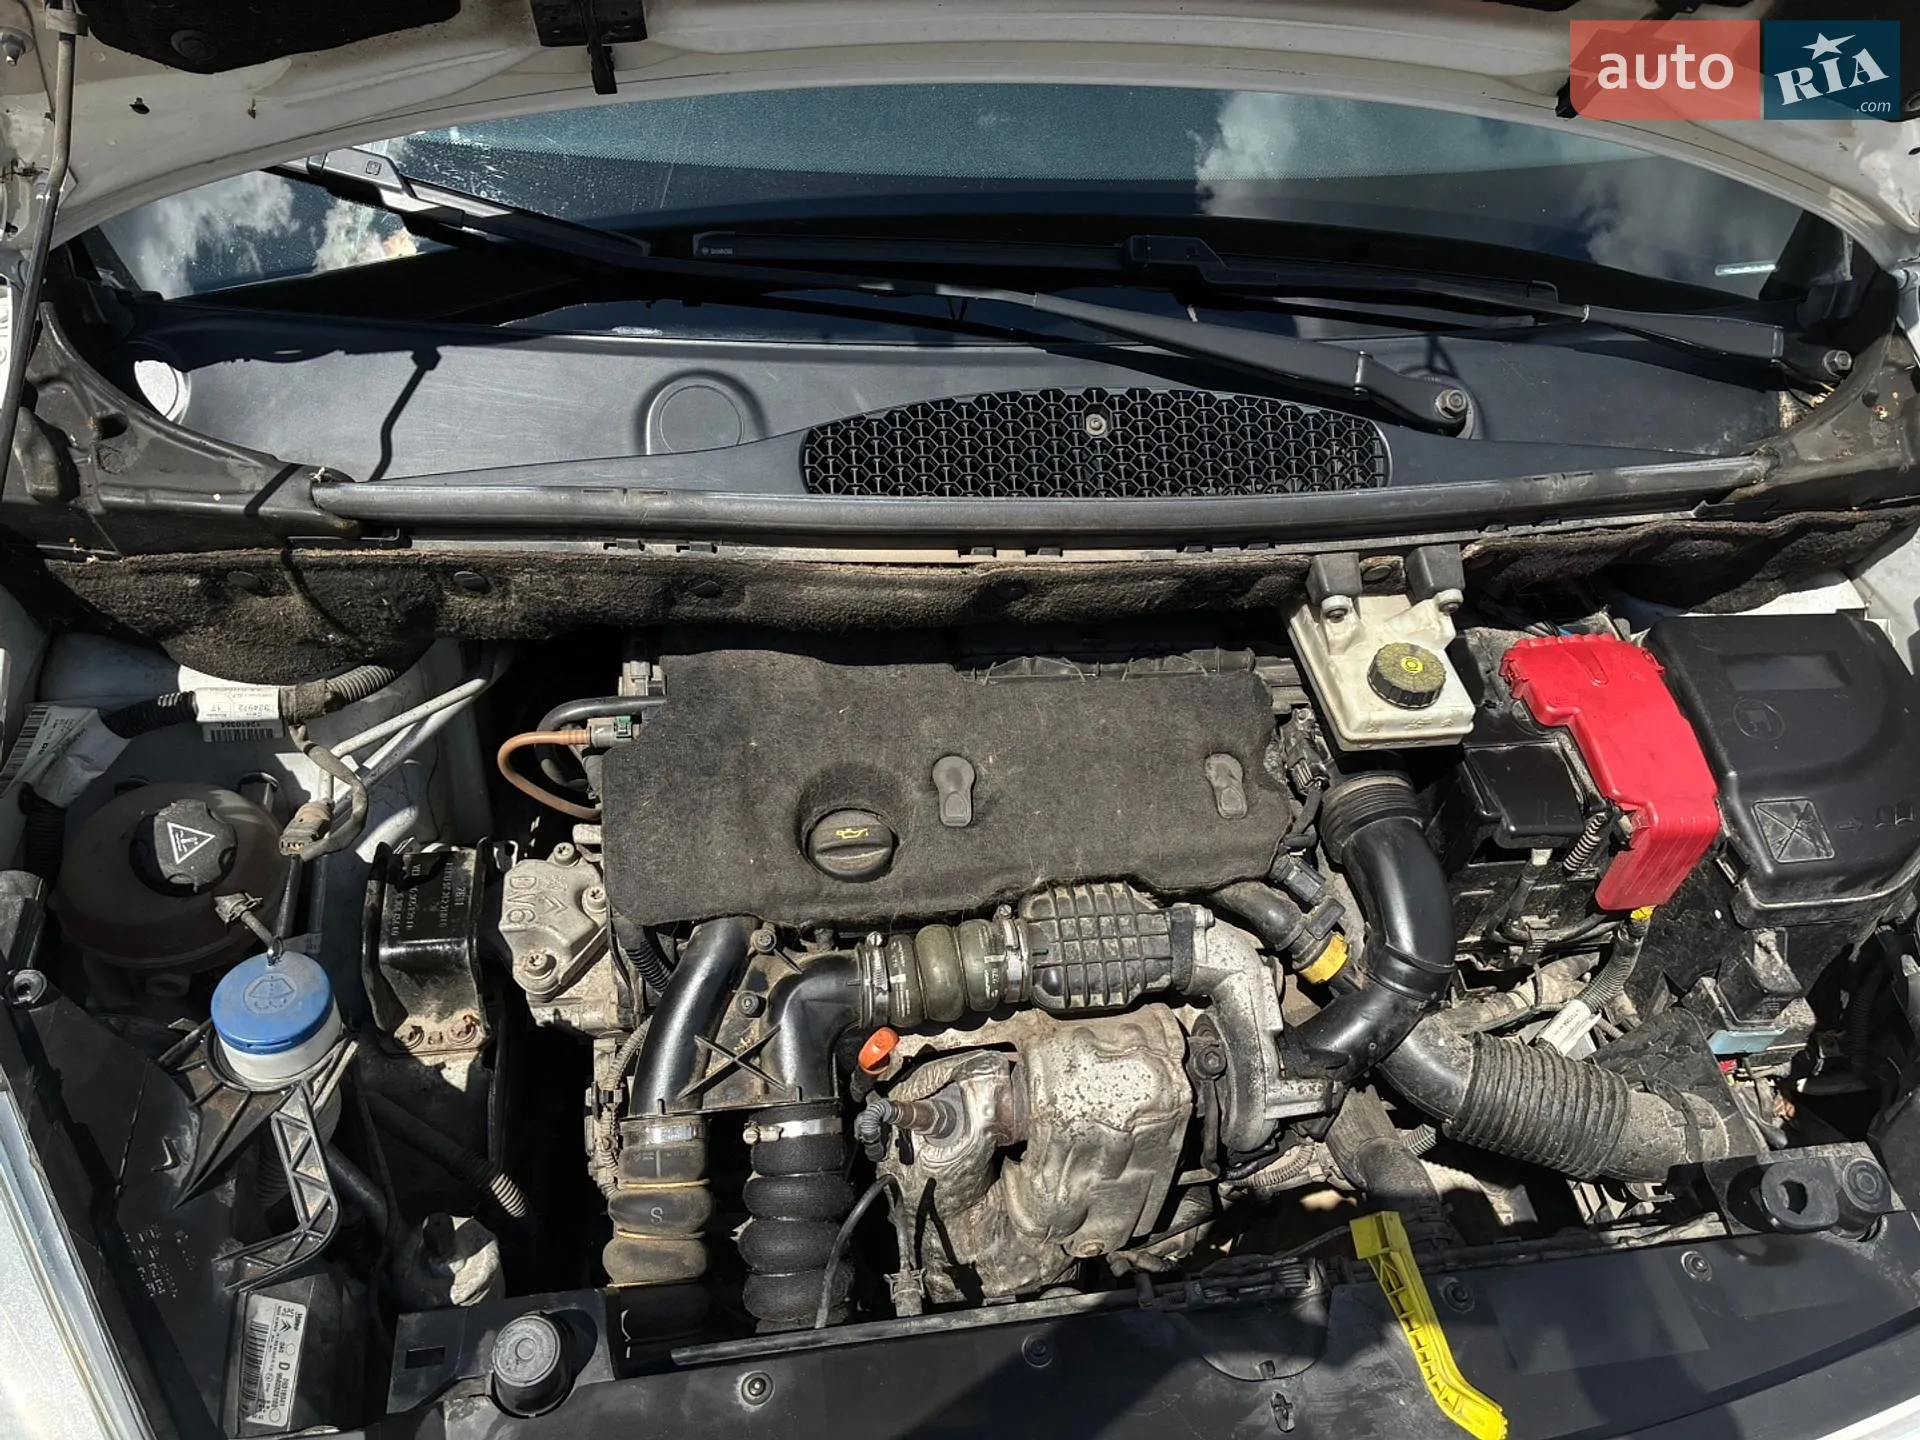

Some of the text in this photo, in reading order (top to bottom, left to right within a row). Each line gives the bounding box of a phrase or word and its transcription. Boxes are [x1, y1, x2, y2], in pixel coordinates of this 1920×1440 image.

[506, 876, 538, 924] DV6
[650, 1206, 663, 1224] S
[279, 1361, 290, 1371] D
